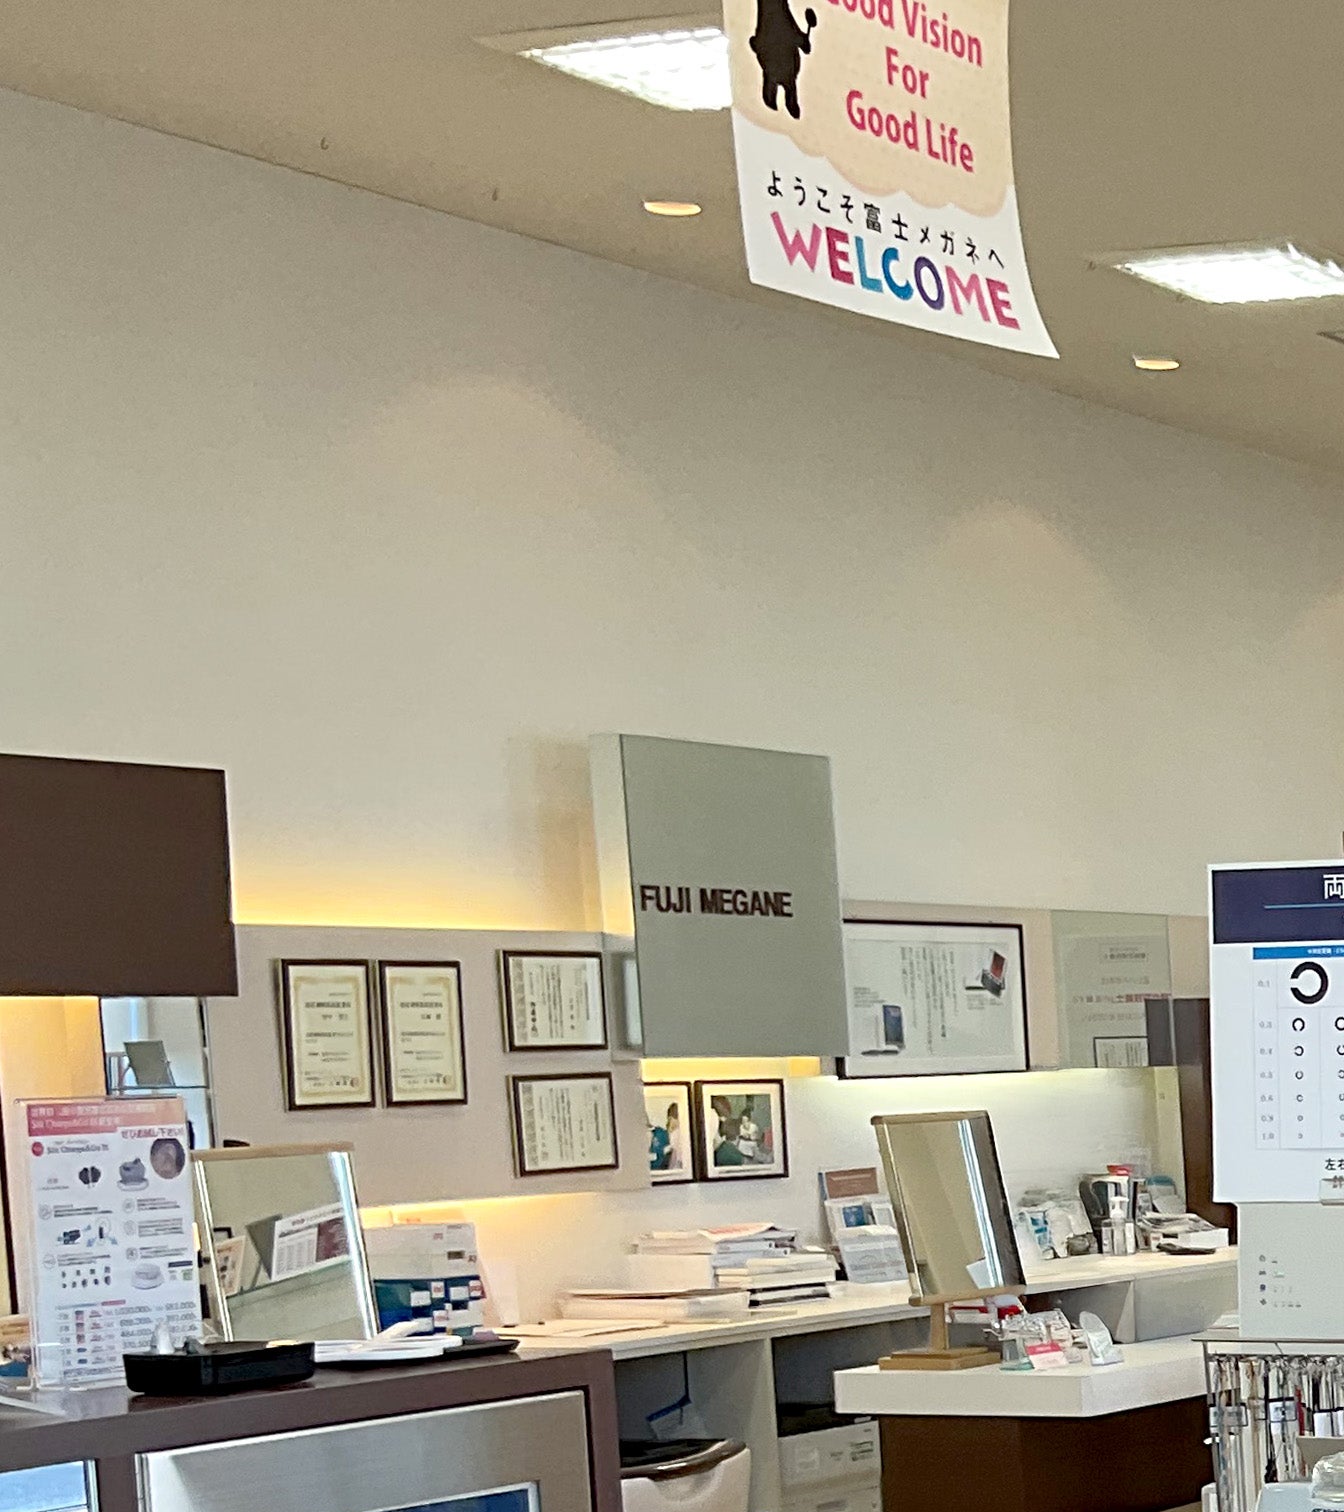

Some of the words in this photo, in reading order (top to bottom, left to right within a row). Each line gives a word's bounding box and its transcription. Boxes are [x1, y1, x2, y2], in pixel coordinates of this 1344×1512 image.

[826, 0, 894, 31] ood
[902, 0, 982, 67] Vision
[886, 46, 930, 100] For
[846, 90, 919, 152] Good
[926, 110, 975, 173] Life
[767, 170, 1005, 269] ようこそ富士メガネへ
[770, 211, 1021, 331] WELCOME
[639, 885, 692, 913] FUJI
[700, 888, 793, 917] MEGANE
